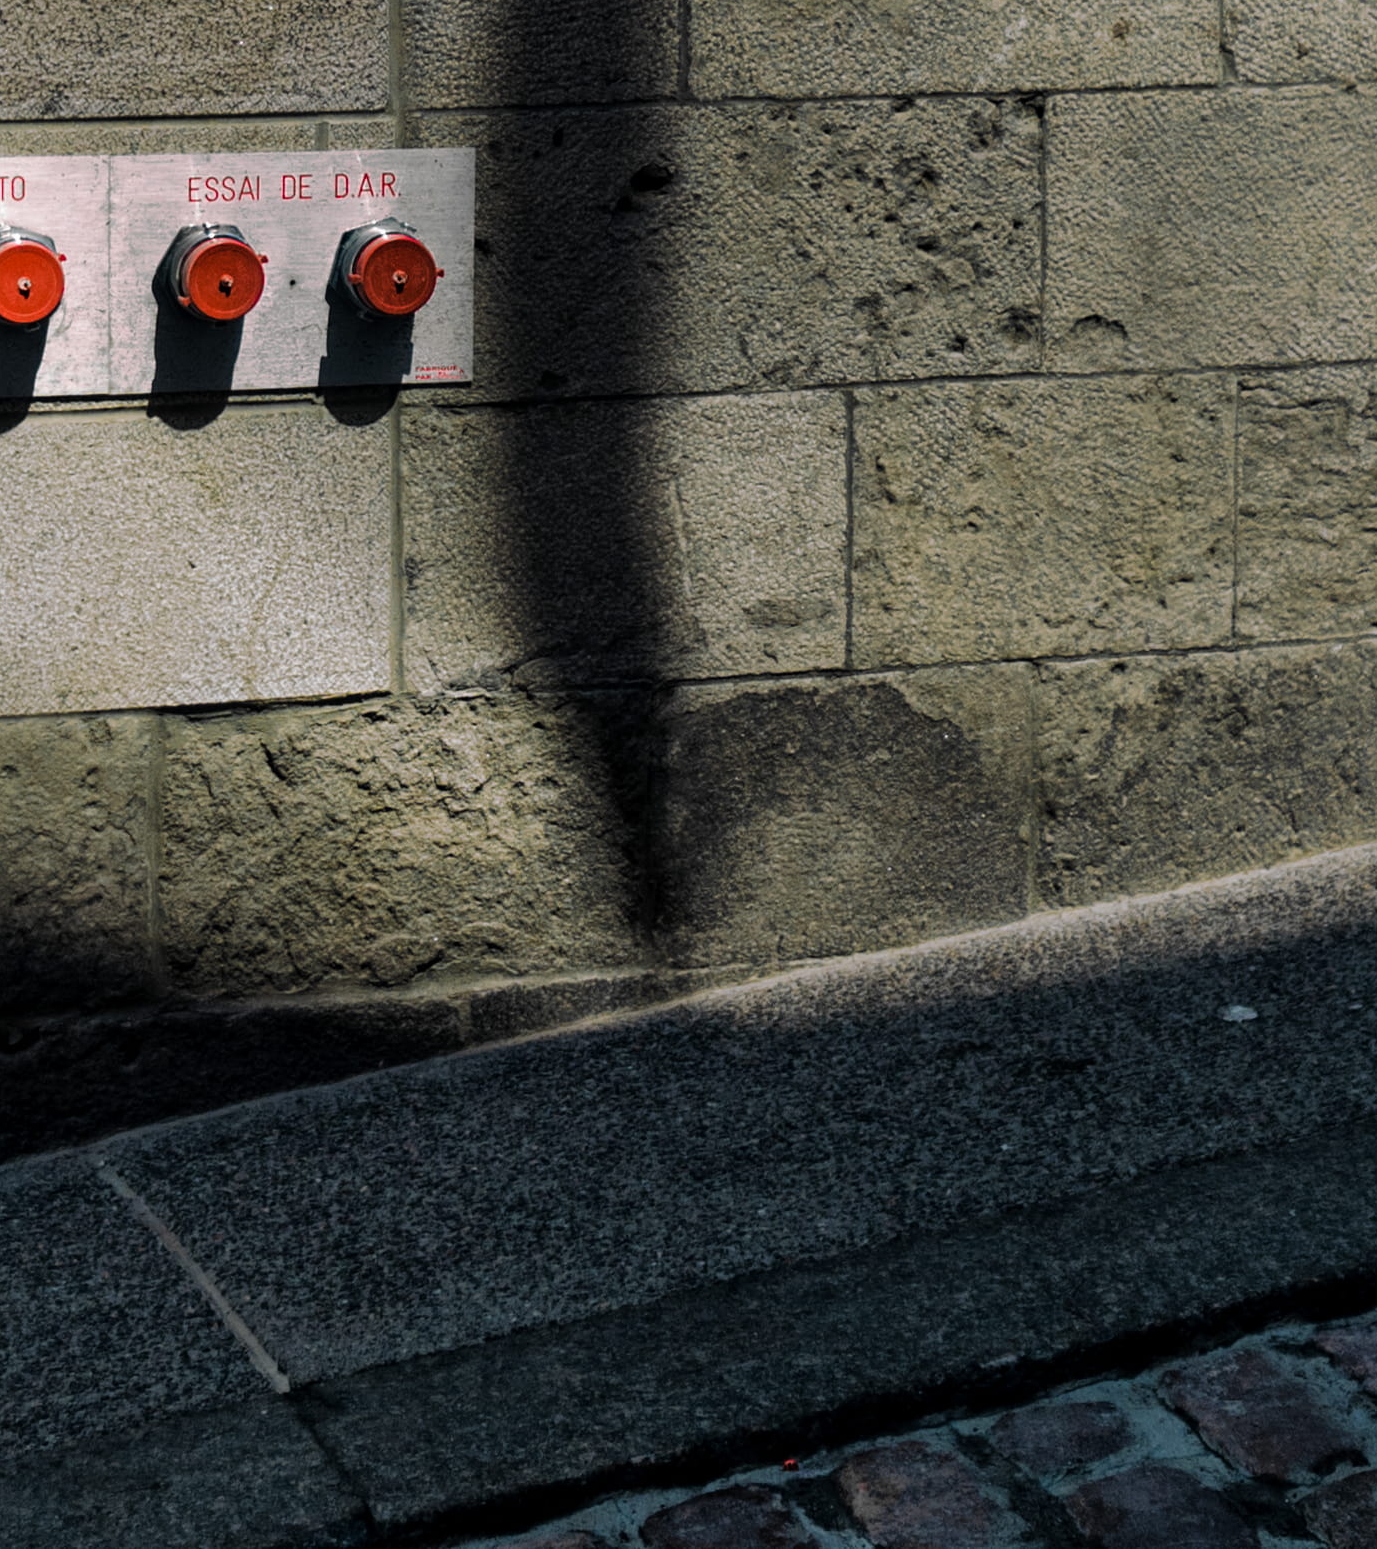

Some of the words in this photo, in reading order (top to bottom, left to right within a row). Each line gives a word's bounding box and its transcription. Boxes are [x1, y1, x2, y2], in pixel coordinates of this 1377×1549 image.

[188, 175, 260, 202] ESSAI
[281, 174, 313, 200] DE
[334, 172, 402, 199] D.A.R.
